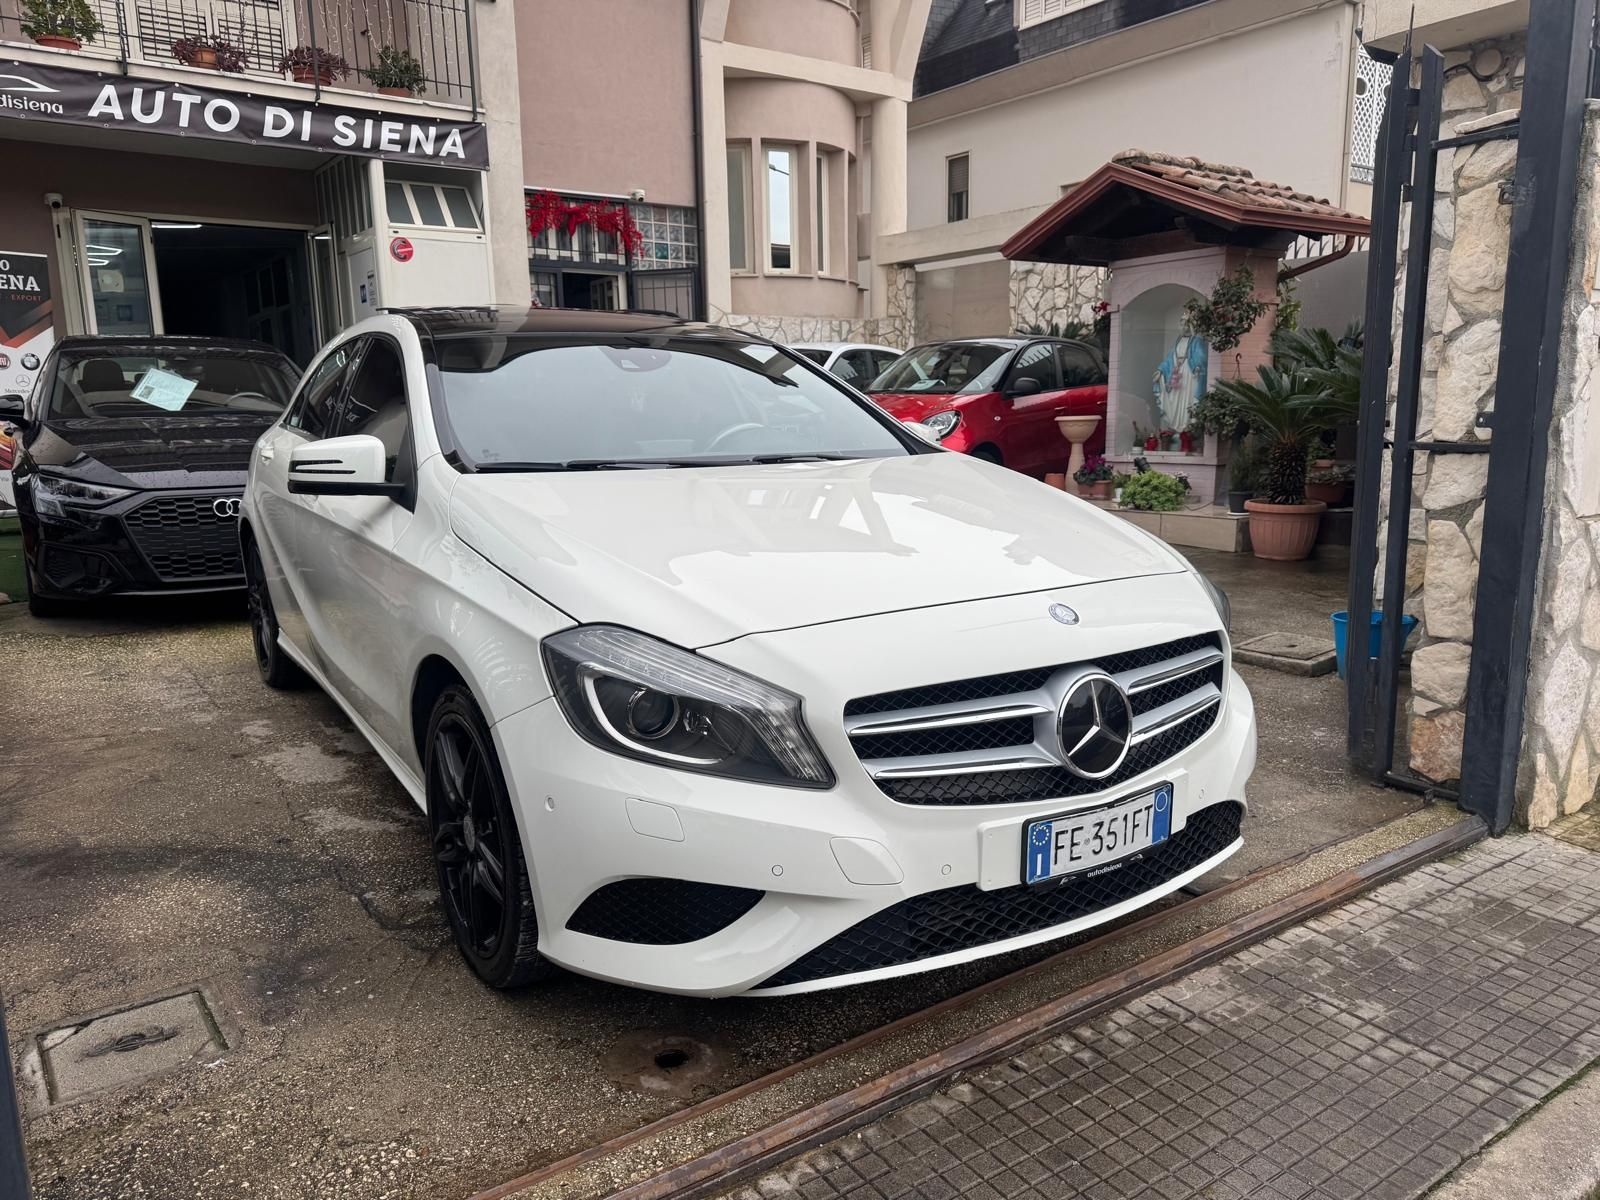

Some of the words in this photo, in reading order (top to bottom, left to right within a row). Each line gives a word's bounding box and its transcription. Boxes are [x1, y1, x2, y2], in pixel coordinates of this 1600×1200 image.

[87, 84, 240, 133] AUTO
[263, 105, 312, 142] DI
[332, 115, 466, 159] SIENA
